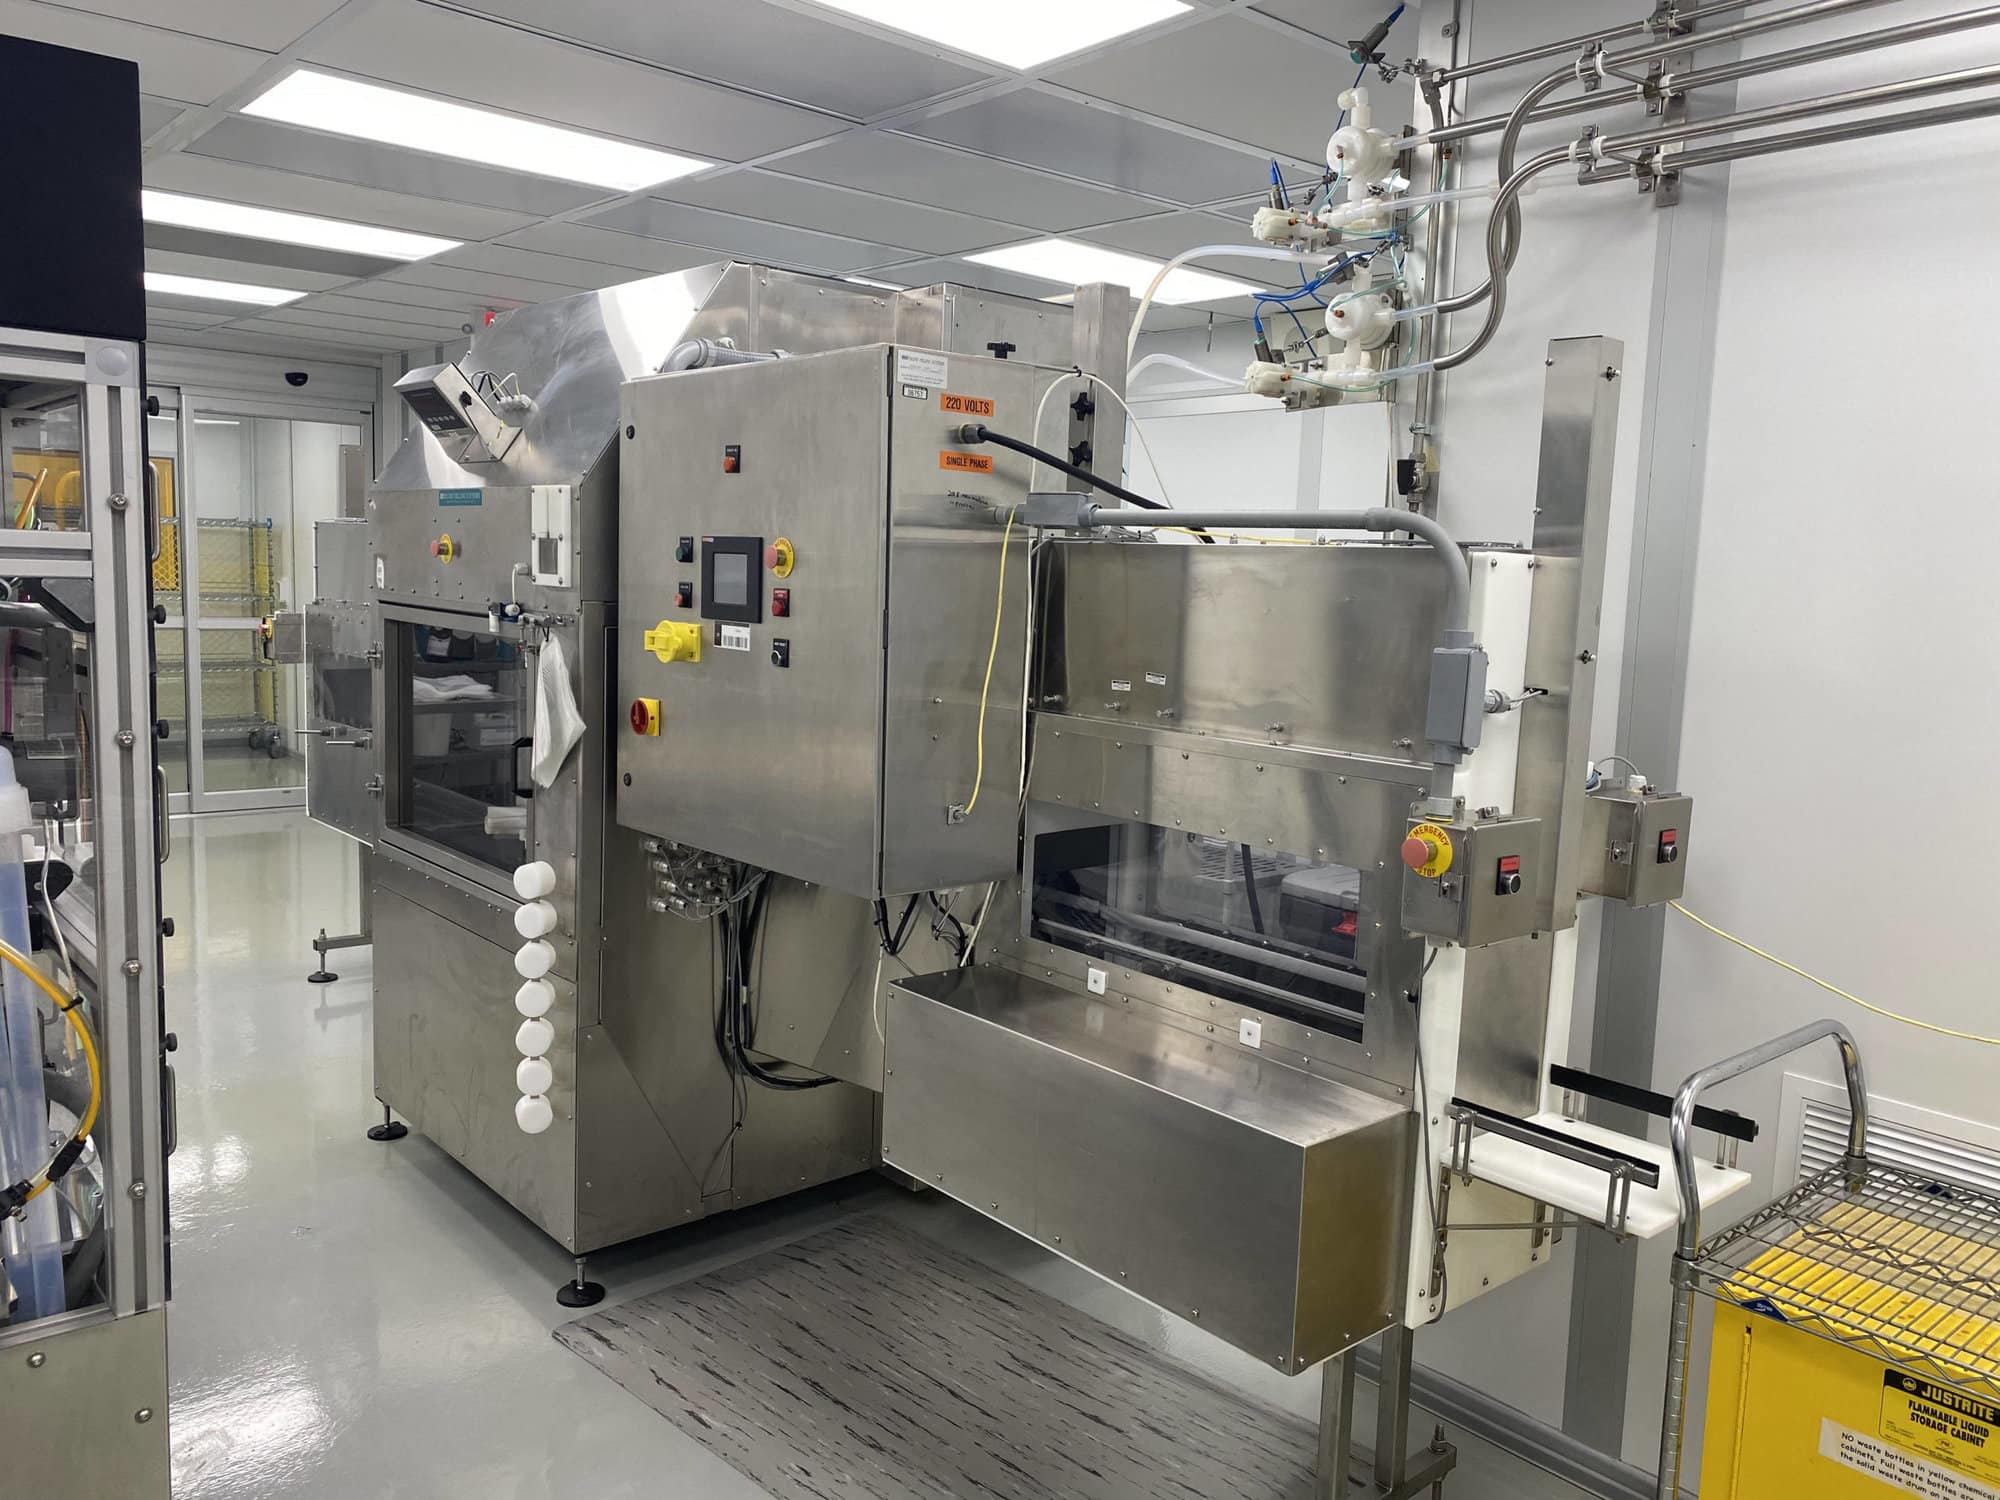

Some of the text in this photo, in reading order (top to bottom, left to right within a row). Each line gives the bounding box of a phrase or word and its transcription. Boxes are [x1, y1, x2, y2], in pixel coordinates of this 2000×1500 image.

[946, 396, 989, 414] 220 VOLTS
[946, 456, 988, 469] SINGLE PHASE
[1908, 1400, 1989, 1438] FLAMMABLE LIQUID
[1922, 1385, 1995, 1421] JUSTRITE
[1910, 1413, 1948, 1434] STORAGE
[1950, 1429, 1985, 1448] CABINET
[1840, 1451, 1940, 1499] the solid waste drum on
[1841, 1432, 1854, 1442] NO
[1857, 1440, 1881, 1454] waste
[1885, 1450, 1914, 1468] bottles
[1918, 1463, 1925, 1472] in
[1928, 1470, 1955, 1485] yellow
[1959, 1482, 1995, 1500] chemical
[1880, 1458, 1895, 1470] Full
[1899, 1468, 1923, 1482] waste
[1927, 1479, 1957, 1496] bottles
